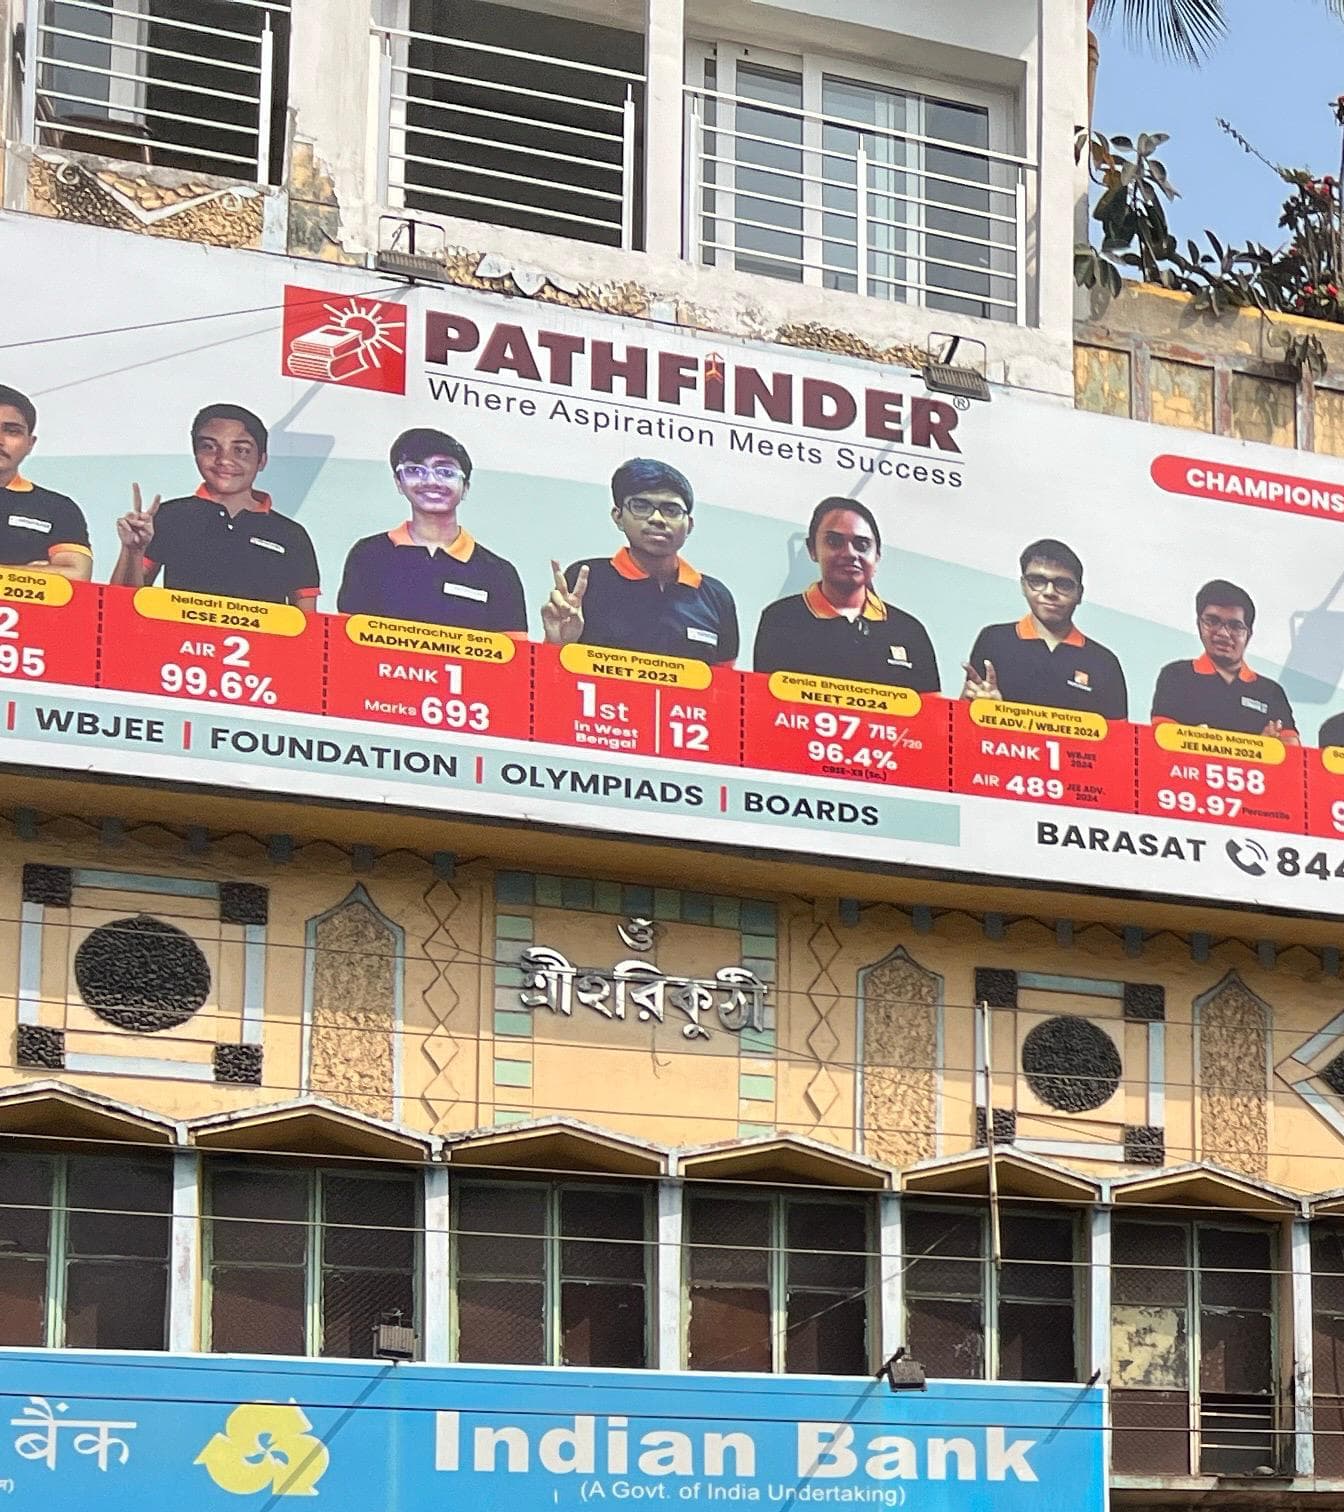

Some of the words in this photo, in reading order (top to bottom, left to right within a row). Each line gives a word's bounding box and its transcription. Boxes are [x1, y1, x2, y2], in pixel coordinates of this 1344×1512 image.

[425, 309, 962, 454] PATHFINDER
[429, 379, 537, 418] Where
[549, 404, 715, 447] Aspiration
[729, 431, 823, 464] Meets
[837, 448, 963, 488] Success
[4, 587, 45, 601] 2024
[181, 609, 217, 624] ICSE
[221, 614, 260, 629] 2024
[368, 620, 462, 641] Chandrachur
[467, 632, 493, 645] Sen
[180, 640, 216, 657] AIR
[222, 635, 250, 668] 2
[359, 633, 461, 655] MADHYAMIK
[464, 646, 503, 660] 2024
[586, 650, 626, 664] Sayan
[630, 655, 685, 671] Pradhan
[160, 663, 278, 705] 99.6%
[378, 663, 438, 685] RANK
[444, 664, 463, 695] 1
[593, 663, 634, 680] NEET
[638, 670, 678, 684] 2023
[576, 682, 629, 721] 1st
[801, 691, 842, 706] NEET
[845, 697, 888, 711] 2024
[820, 680, 908, 700] Bhattacharya
[364, 699, 417, 717] Marks
[421, 696, 490, 731] 693
[669, 704, 707, 721] AIR
[774, 712, 809, 731] AIR
[815, 712, 861, 740] 97
[994, 703, 1048, 720] Kingshuk
[1051, 710, 1082, 723] Patra
[574, 720, 591, 732] In
[594, 724, 639, 739] West
[575, 732, 637, 750] Bengal
[669, 721, 710, 751] 12
[979, 716, 999, 726] JEE
[1000, 717, 1027, 731] ADV.
[1036, 722, 1072, 735] WBJEE
[1074, 726, 1100, 738] 2024
[808, 740, 898, 771] 96.4%
[981, 740, 1040, 761] RANK
[1045, 740, 1060, 771] 1
[1180, 742, 1200, 752] JEE
[1201, 743, 1233, 756] MAIN
[1235, 747, 1262, 760] 2024
[36, 707, 164, 743] WBJEE
[209, 727, 458, 778] FOUNDATION
[500, 762, 704, 807] OLYMPIADS
[744, 791, 879, 826] BOARDS
[1170, 765, 1199, 781] AIR
[1205, 763, 1266, 795] 558
[972, 773, 1000, 788] AIR
[1005, 775, 1064, 800] 489
[1157, 788, 1242, 818] 99.97
[1037, 821, 1207, 865] BARASAT
[10, 1395, 138, 1472] बैंक
[434, 1410, 755, 1478] Indian
[797, 1420, 1039, 1482] Bank
[580, 1480, 605, 1502] (A
[612, 1481, 671, 1501] Govt.
[679, 1481, 701, 1501] of
[707, 1483, 761, 1502] India
[767, 1483, 906, 1507] Undertaking)
